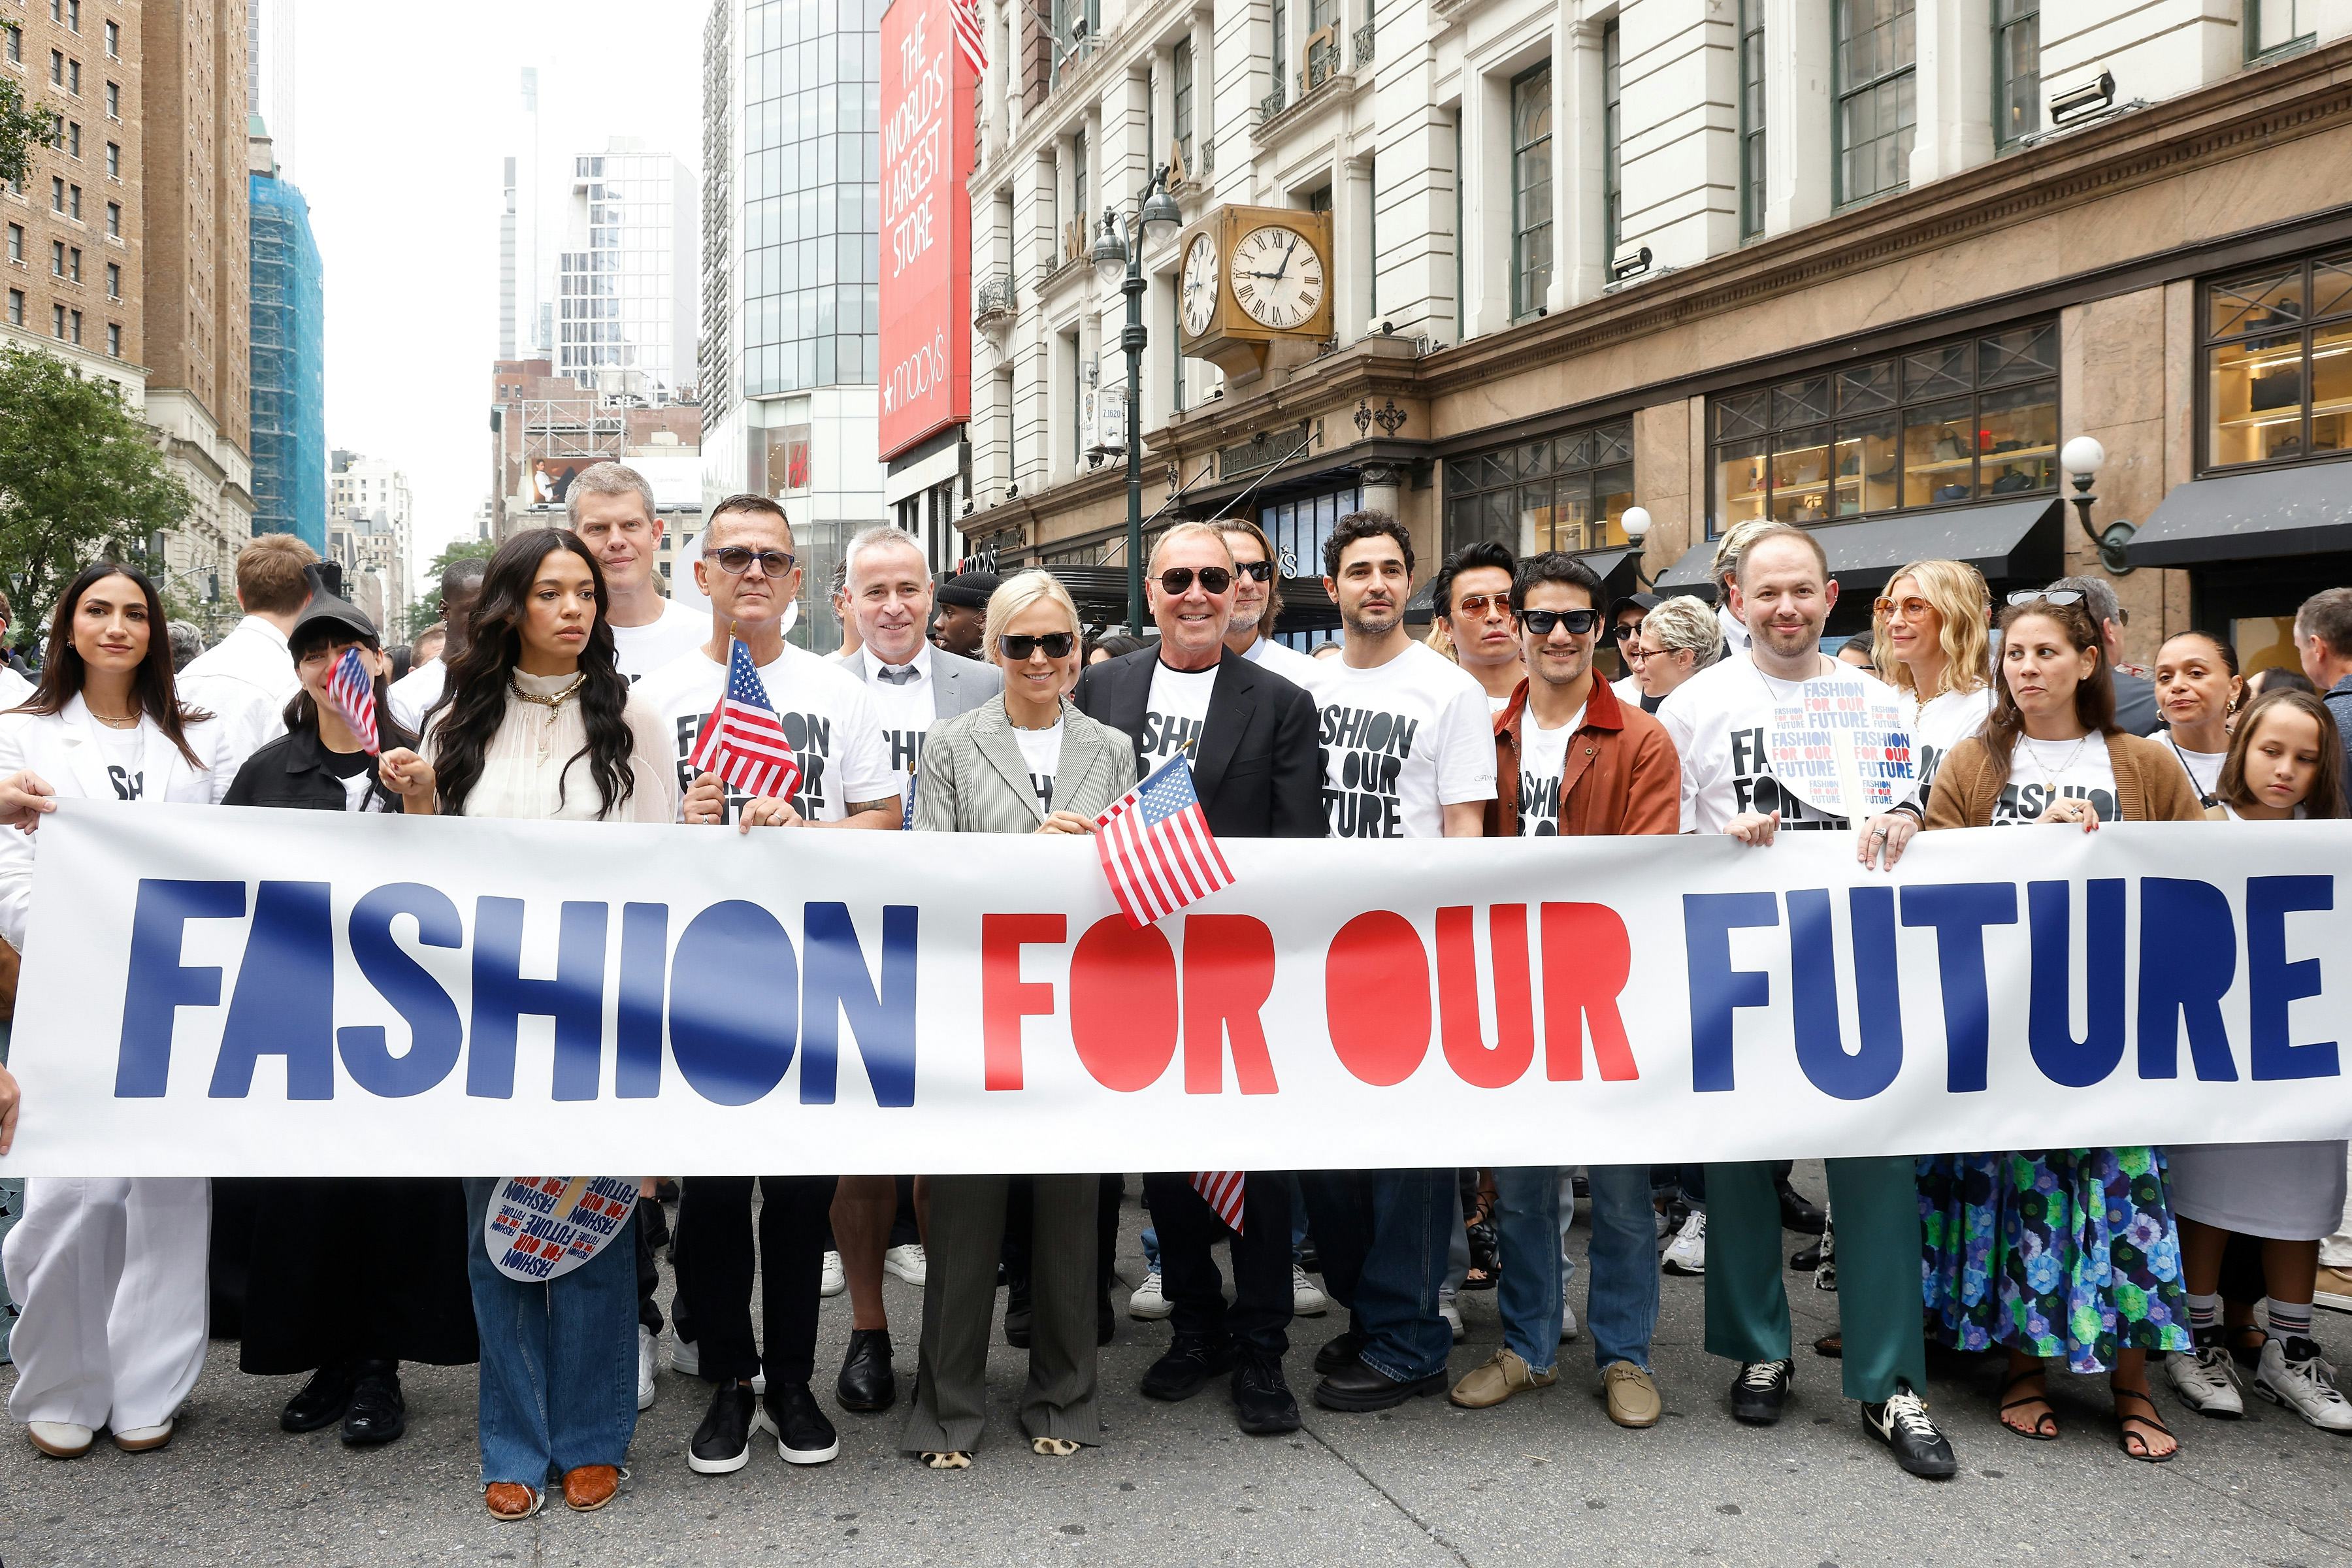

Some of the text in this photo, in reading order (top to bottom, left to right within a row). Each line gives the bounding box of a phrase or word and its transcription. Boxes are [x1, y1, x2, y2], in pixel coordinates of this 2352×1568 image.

[901, 11, 926, 89] THE
[885, 52, 943, 169] WORLD'S
[885, 117, 941, 227] LARGEST
[893, 192, 934, 278] STORE
[1272, 233, 1283, 248] XII
[1253, 235, 1267, 253] XI
[1241, 250, 1255, 263] X
[894, 325, 944, 412] macy's
[1803, 682, 1865, 697] FASHION
[1804, 697, 1865, 711] FOR OUR
[1777, 721, 1805, 729] FUTURE
[1808, 712, 1869, 728] FUTURE
[1318, 704, 1418, 759] SHION
[1771, 732, 1832, 747] FASHION
[1853, 731, 1910, 748] FASHION
[1772, 746, 1832, 760] FOR OUR
[1854, 747, 1910, 762] FOR OUR
[1343, 751, 1401, 795] OUR
[1776, 760, 1836, 777] FUTURE
[1858, 762, 1914, 779] FUTURE
[1863, 780, 1891, 789] FASHION
[1812, 795, 1841, 804] FUTURE
[1865, 796, 1893, 804] FUTURE
[1322, 789, 1404, 838] TURE
[115, 874, 2341, 1109] FASHION FOR OUR FUTURE
[502, 1181, 557, 1215] FASHION
[587, 1177, 639, 1205] FUTURE
[499, 1205, 527, 1220] FUTURE
[580, 1191, 629, 1220] FOR OUR
[490, 1220, 517, 1237] FASHION
[496, 1214, 522, 1228] FOR OUR
[566, 1205, 618, 1235] FASHION
[521, 1214, 578, 1245] FUTURE
[576, 1232, 600, 1245] FUTURE
[513, 1233, 566, 1262] FOR OUR
[566, 1247, 590, 1260] FASHION
[583, 1243, 595, 1253] FOR
[499, 1248, 555, 1278] FASHION
